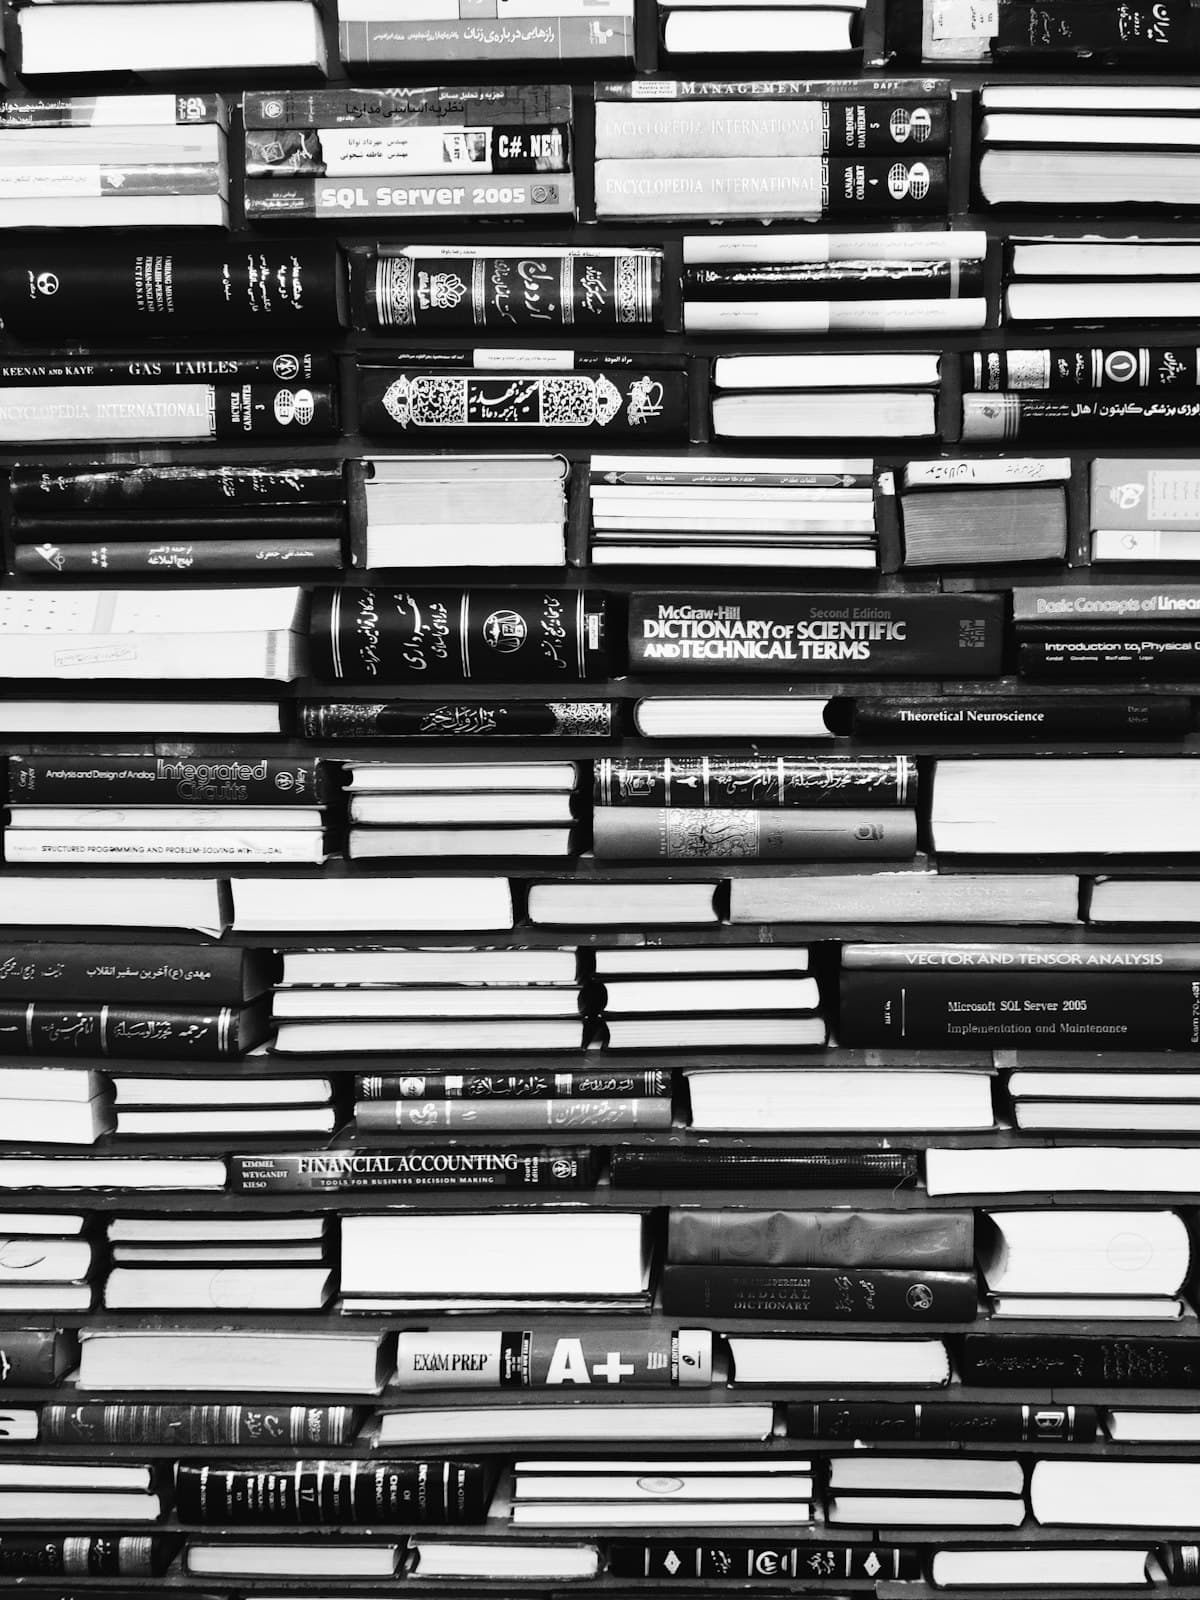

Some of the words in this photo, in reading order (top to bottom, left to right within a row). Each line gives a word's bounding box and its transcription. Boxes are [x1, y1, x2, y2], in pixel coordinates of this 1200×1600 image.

[1147, 4, 1170, 43] ایران
[681, 80, 813, 95] MANAGEMENT
[606, 119, 703, 136] ENCYCLOPEDIA
[711, 119, 815, 135] INTERNATIONAL
[606, 177, 703, 194] ENCYCLOPEDIA
[711, 176, 815, 193] INTERNATIONAL
[845, 166, 853, 198] CANADA
[856, 165, 865, 200] COLBERT
[322, 188, 369, 207] SQL
[376, 186, 465, 206] Server
[472, 187, 525, 204] 2005
[135, 256, 144, 311] DICTIONARY
[3, 367, 46, 377] KEENAN
[65, 366, 94, 376] KAYE
[128, 362, 162, 376] GAS
[174, 360, 239, 375] TABLES
[304, 353, 312, 379] WILEY
[0, 404, 89, 420] NCYCLOPEDIA
[96, 402, 204, 419] INTERNATIONAL
[231, 392, 240, 423] BICYCLE
[658, 605, 741, 619] McGraw-Hill
[809, 607, 849, 619] Second
[852, 607, 891, 619] Edition
[1037, 598, 1073, 613] Basic
[1074, 598, 1140, 615] Concepts
[1141, 596, 1157, 610] of
[643, 620, 772, 639] DICTIONARY
[772, 625, 794, 639] OF
[797, 621, 906, 641] SCIENTIFIC
[643, 644, 680, 658] AND
[679, 640, 797, 659] TECHNICAL
[799, 641, 870, 660] TERMS
[1045, 642, 1121, 651] Introduction
[1142, 642, 1192, 653] Physical
[899, 710, 963, 721] Theoretical
[967, 711, 1045, 721] Neuroscience
[19, 770, 27, 788] Gray
[94, 770, 118, 782] Design
[157, 759, 267, 785] Integrated
[295, 767, 308, 794] Wiley
[177, 779, 248, 801] Circuits
[904, 953, 974, 965] VECTOR
[977, 953, 1014, 965] AND
[1018, 953, 1082, 965] TENSOR
[1086, 953, 1164, 966] ANALYSIS
[948, 1000, 996, 1012] Microsoft
[1000, 1001, 1021, 1012] SQL
[1023, 1001, 1059, 1011] Server
[1062, 1000, 1087, 1011] 2005
[947, 1023, 1031, 1036] Implementation
[1035, 1023, 1056, 1034] and
[1060, 1022, 1128, 1034] Maintenance
[1191, 1021, 1200, 1043] Exam
[242, 1159, 275, 1168] KIMMEL
[298, 1156, 393, 1174] FINANCIAL
[399, 1154, 518, 1171] ACCOUNTING
[242, 1170, 288, 1179] WEYGANDT
[243, 1181, 267, 1189] KIESO
[734, 1302, 811, 1311] DICTIONARY
[413, 1354, 449, 1371] EXAM
[452, 1353, 489, 1371] PREP
[545, 1338, 634, 1384] A+
[301, 1488, 315, 1502] 17
